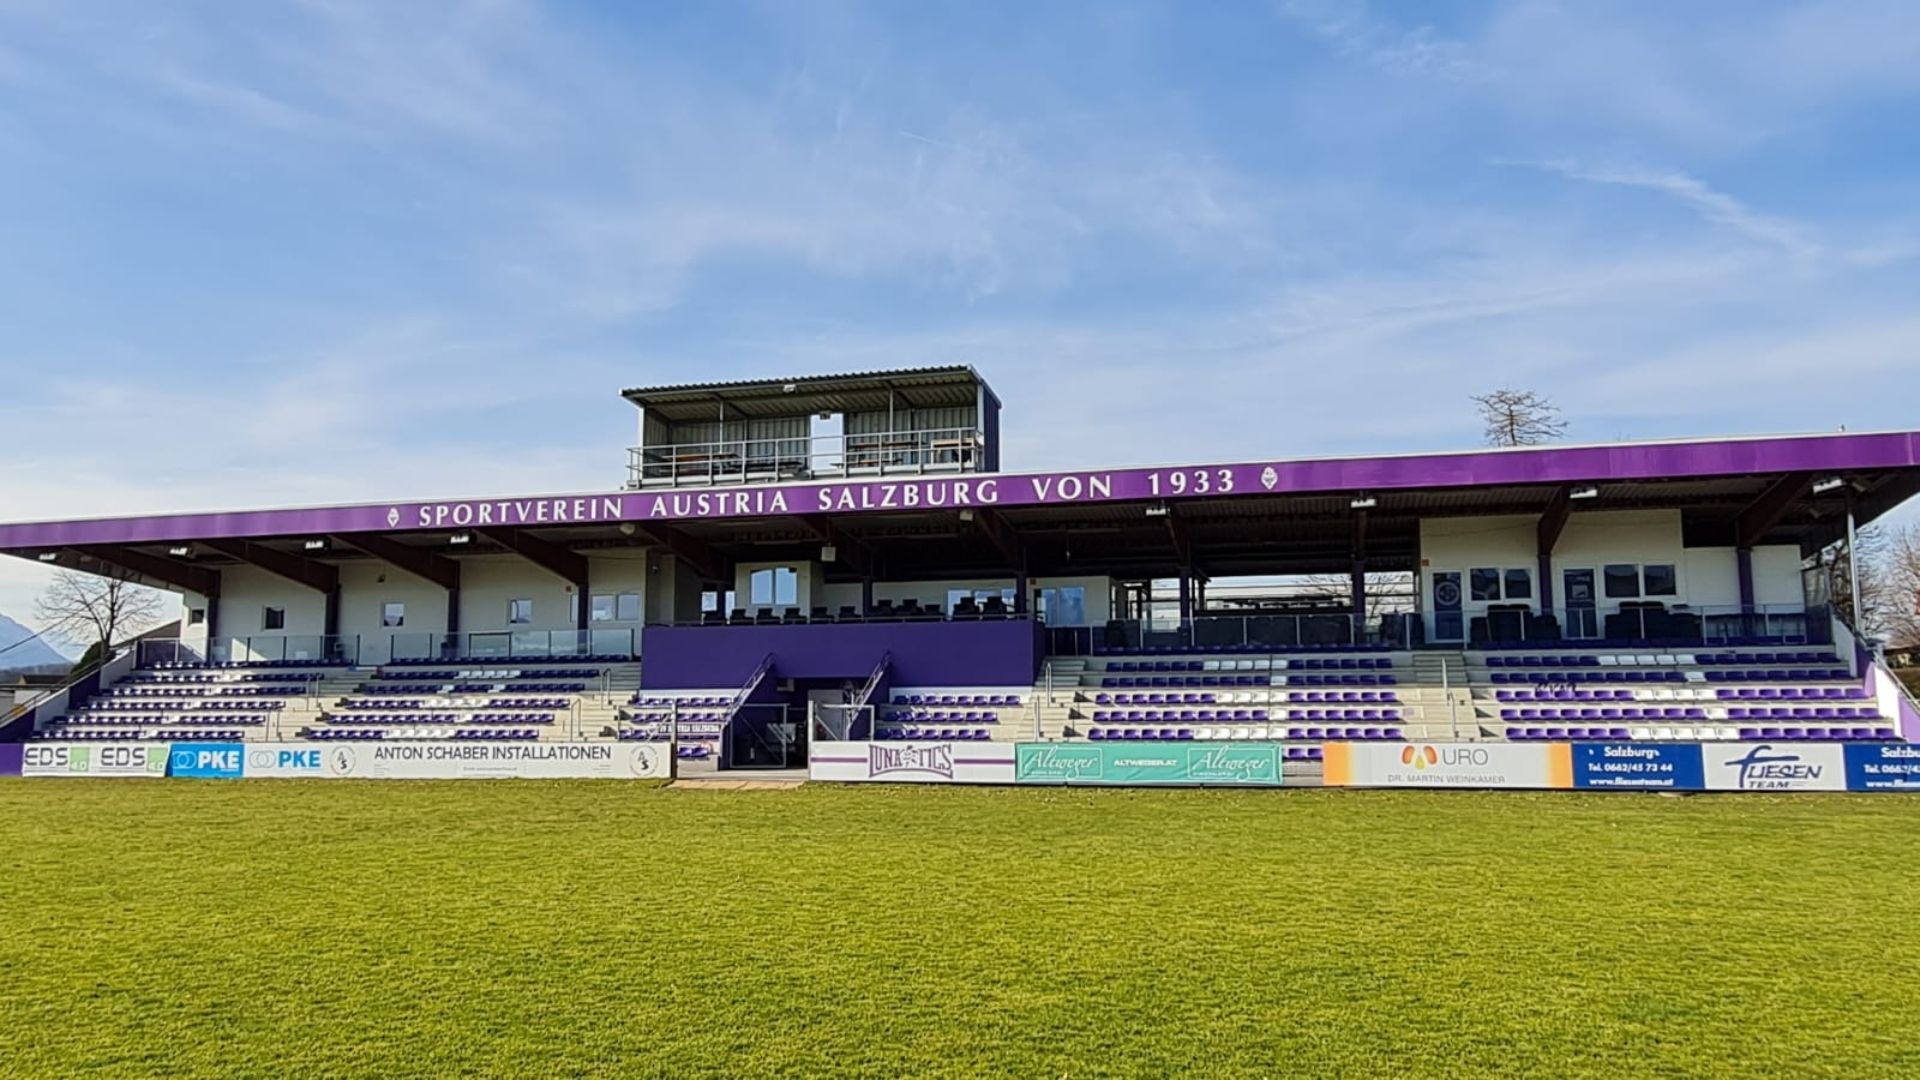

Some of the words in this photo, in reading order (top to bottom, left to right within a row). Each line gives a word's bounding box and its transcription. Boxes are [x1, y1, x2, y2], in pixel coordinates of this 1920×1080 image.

[418, 498, 623, 527] SPORTVEREIN
[650, 490, 788, 518] AUSTRIA
[818, 480, 999, 511] SALZBURG
[1032, 475, 1111, 500] VON
[1148, 469, 1234, 496] 1933
[24, 747, 68, 766] EDS
[100, 747, 145, 766] EDS
[198, 751, 239, 769] PKE
[278, 750, 321, 767] PKE
[374, 746, 423, 760] ANTON
[426, 746, 489, 760] SCHABER
[492, 746, 612, 760] INSTALLATIONEN
[1442, 748, 1489, 766] URO
[1660, 763, 1673, 772] 44
[1407, 774, 1444, 784] MARTIN
